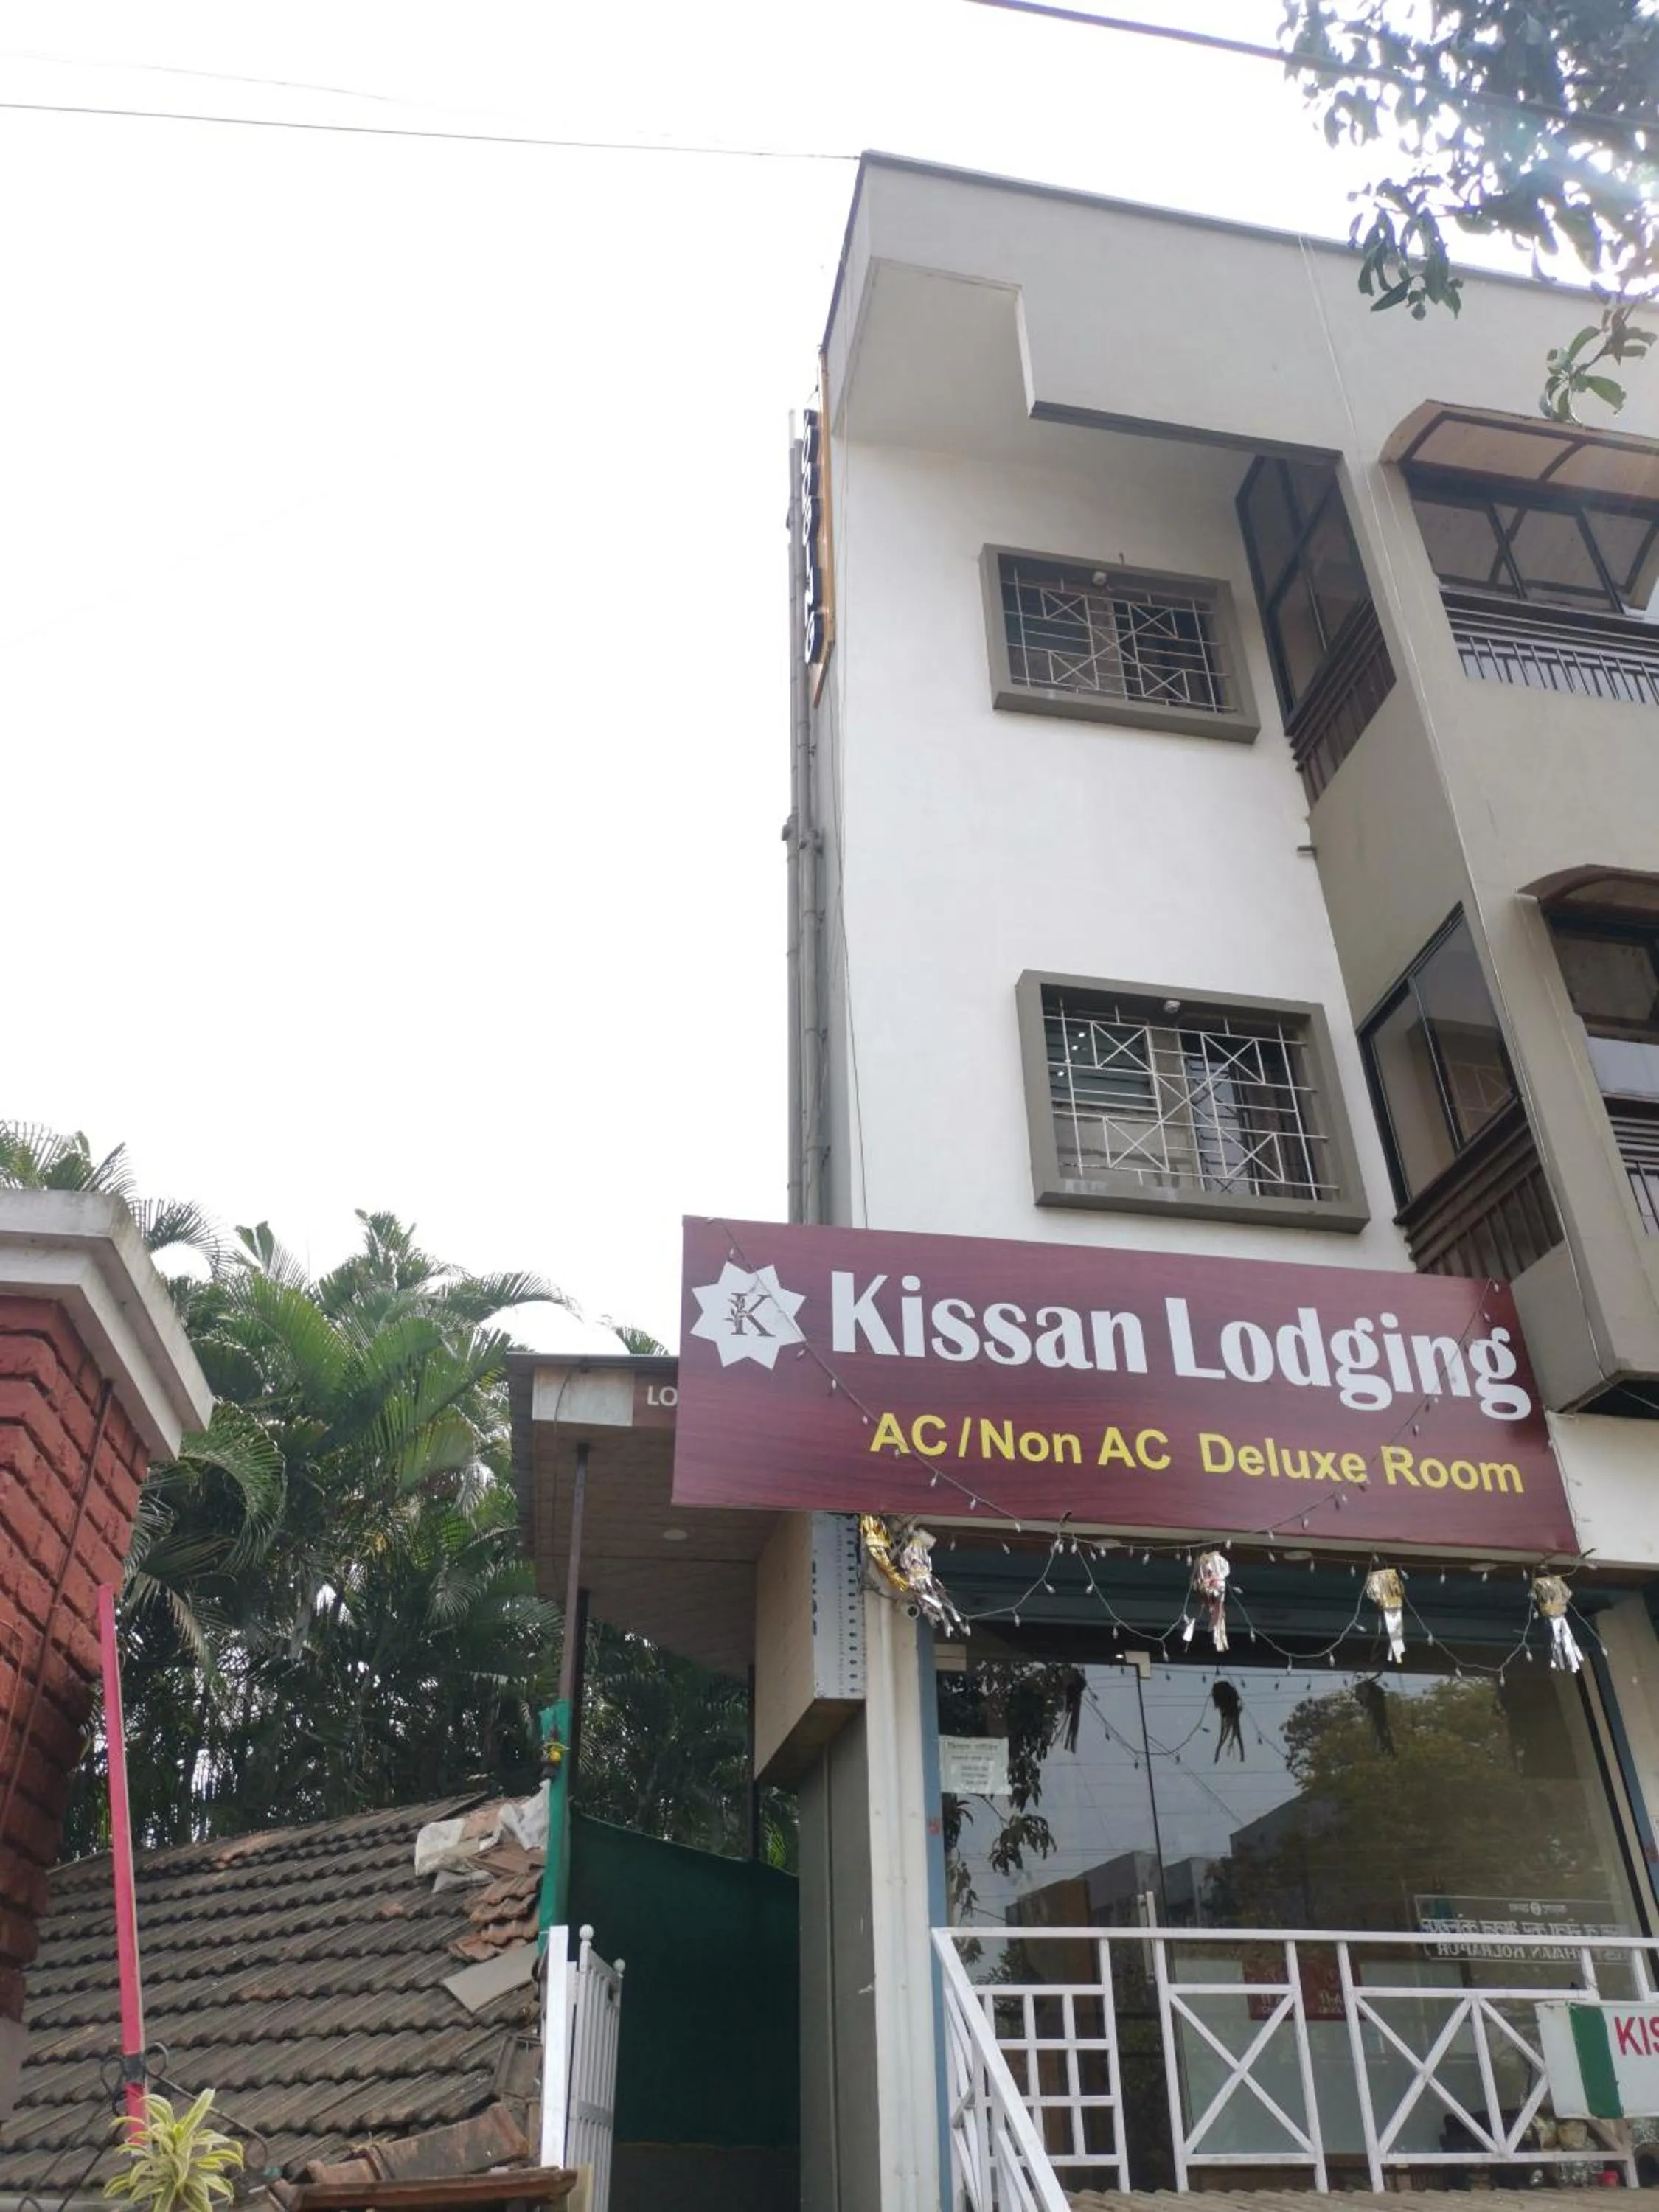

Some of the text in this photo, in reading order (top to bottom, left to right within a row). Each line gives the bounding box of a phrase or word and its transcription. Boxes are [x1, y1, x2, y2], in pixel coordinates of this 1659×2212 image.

[831, 1270, 1531, 1419] Kissan Lodging
[1098, 1426, 1171, 1471] AC
[1199, 1432, 1368, 1483] Deluxe
[1380, 1444, 1524, 1494] Room
